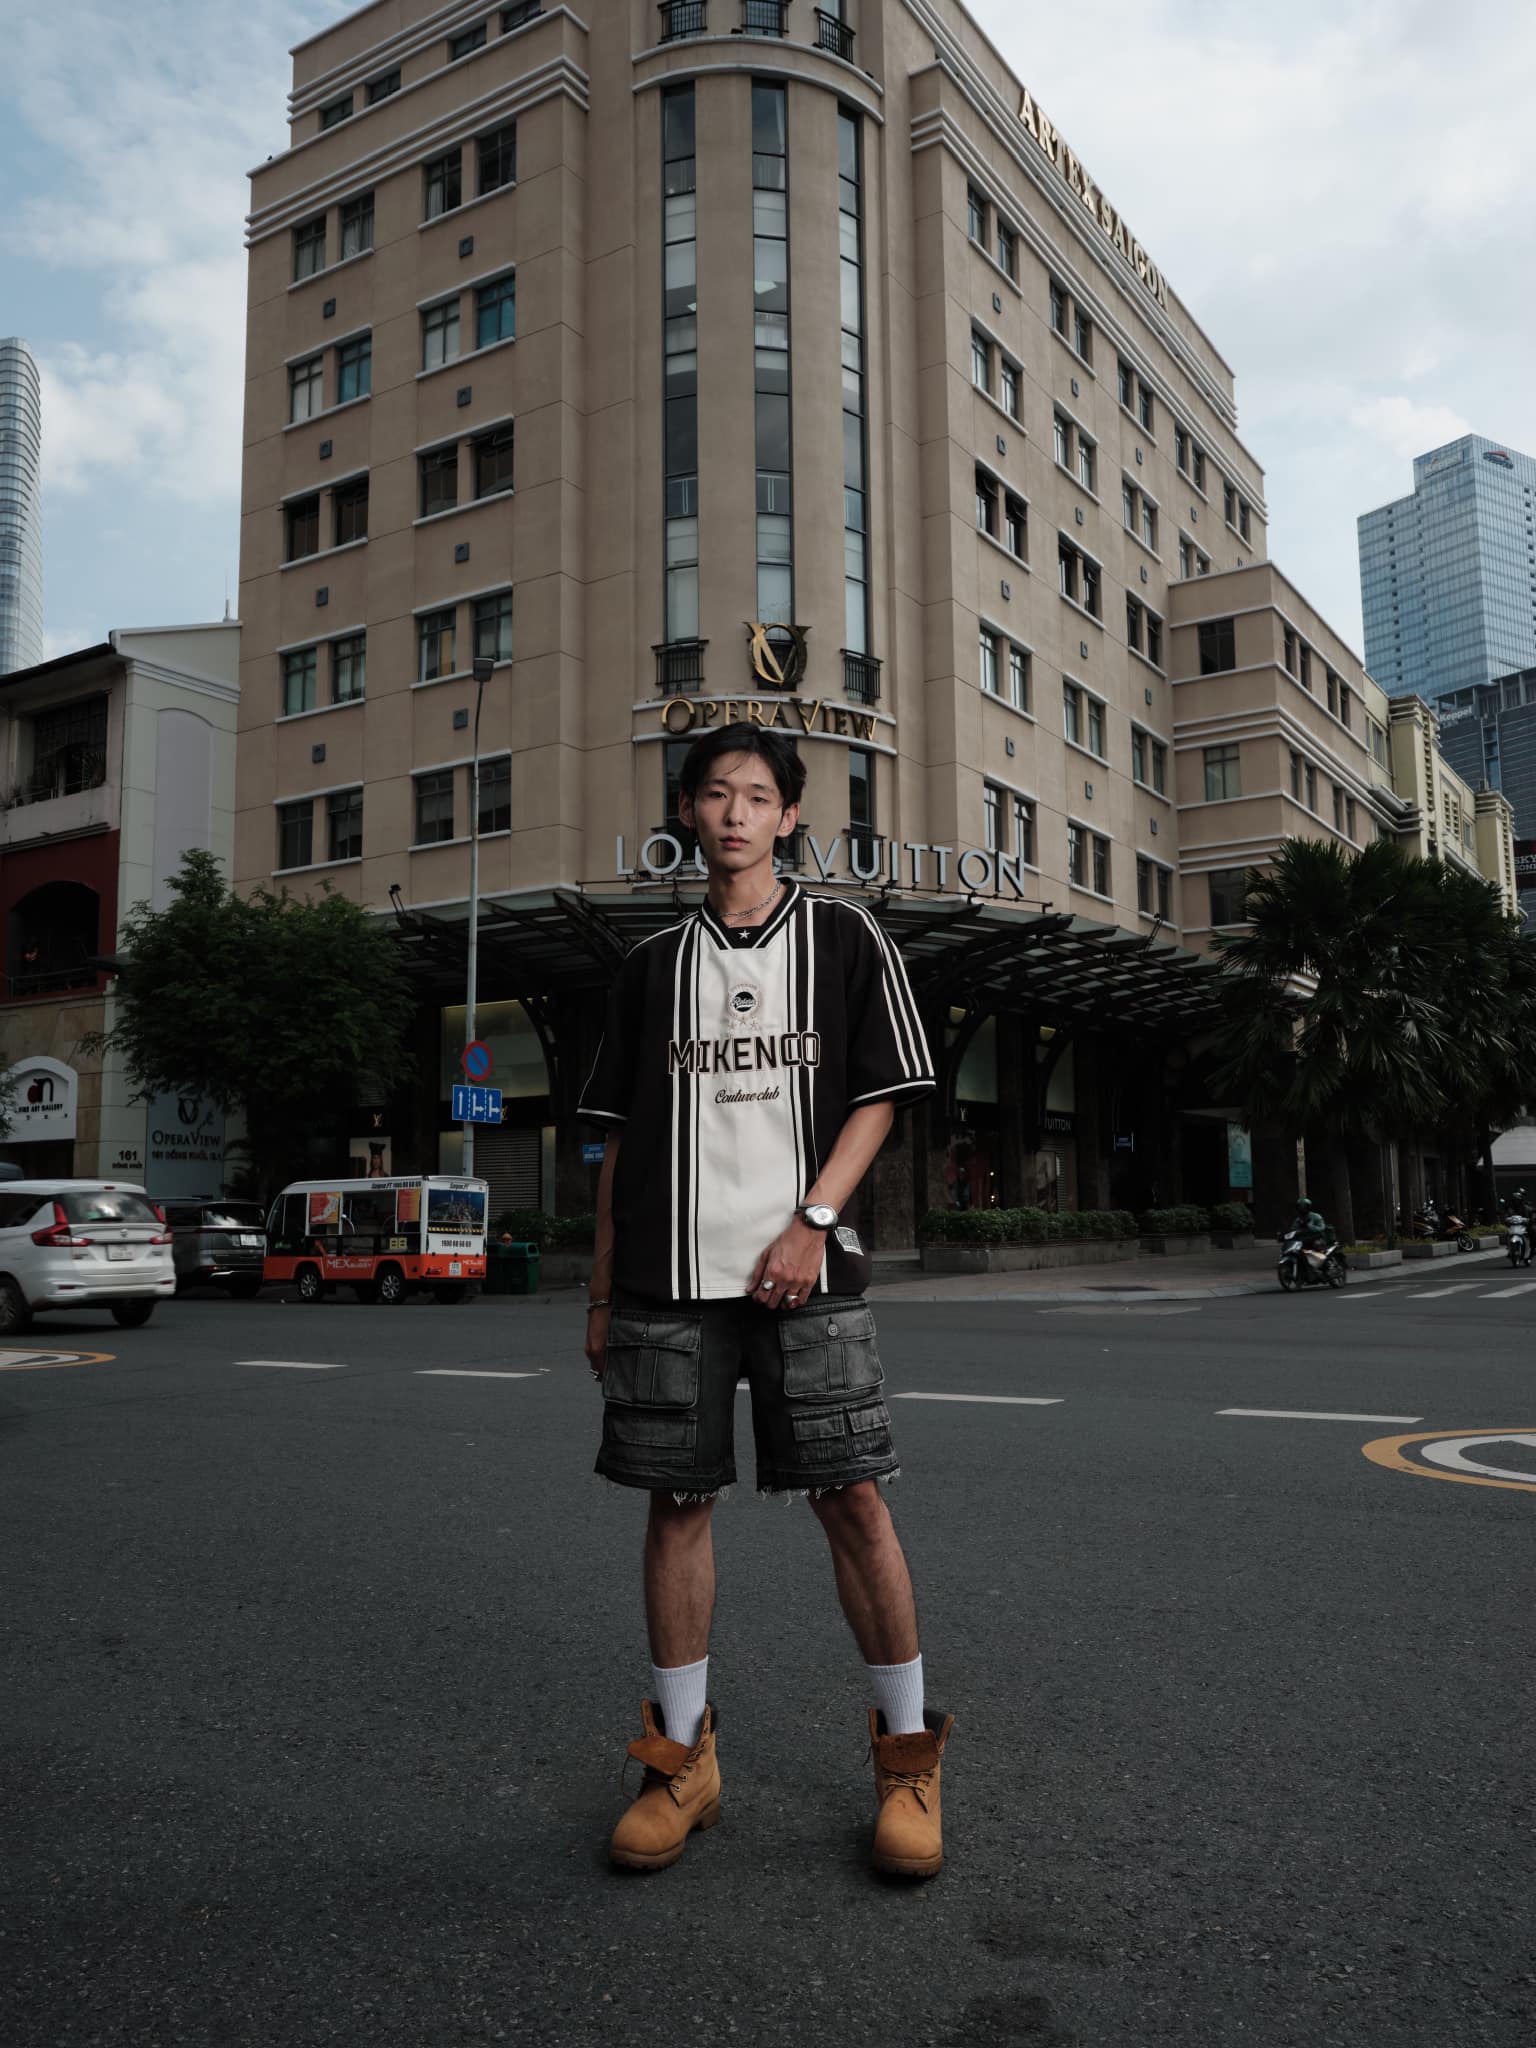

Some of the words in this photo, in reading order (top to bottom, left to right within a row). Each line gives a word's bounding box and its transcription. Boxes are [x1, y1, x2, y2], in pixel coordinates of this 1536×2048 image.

[1018, 88, 1098, 215] ARTEX
[1098, 195, 1169, 313] SAIGON
[806, 836, 1027, 898] VUITTON
[668, 1032, 820, 1074] MIKENCO
[714, 1088, 757, 1104] Couture
[756, 1086, 780, 1101] club
[118, 1150, 137, 1161] 161
